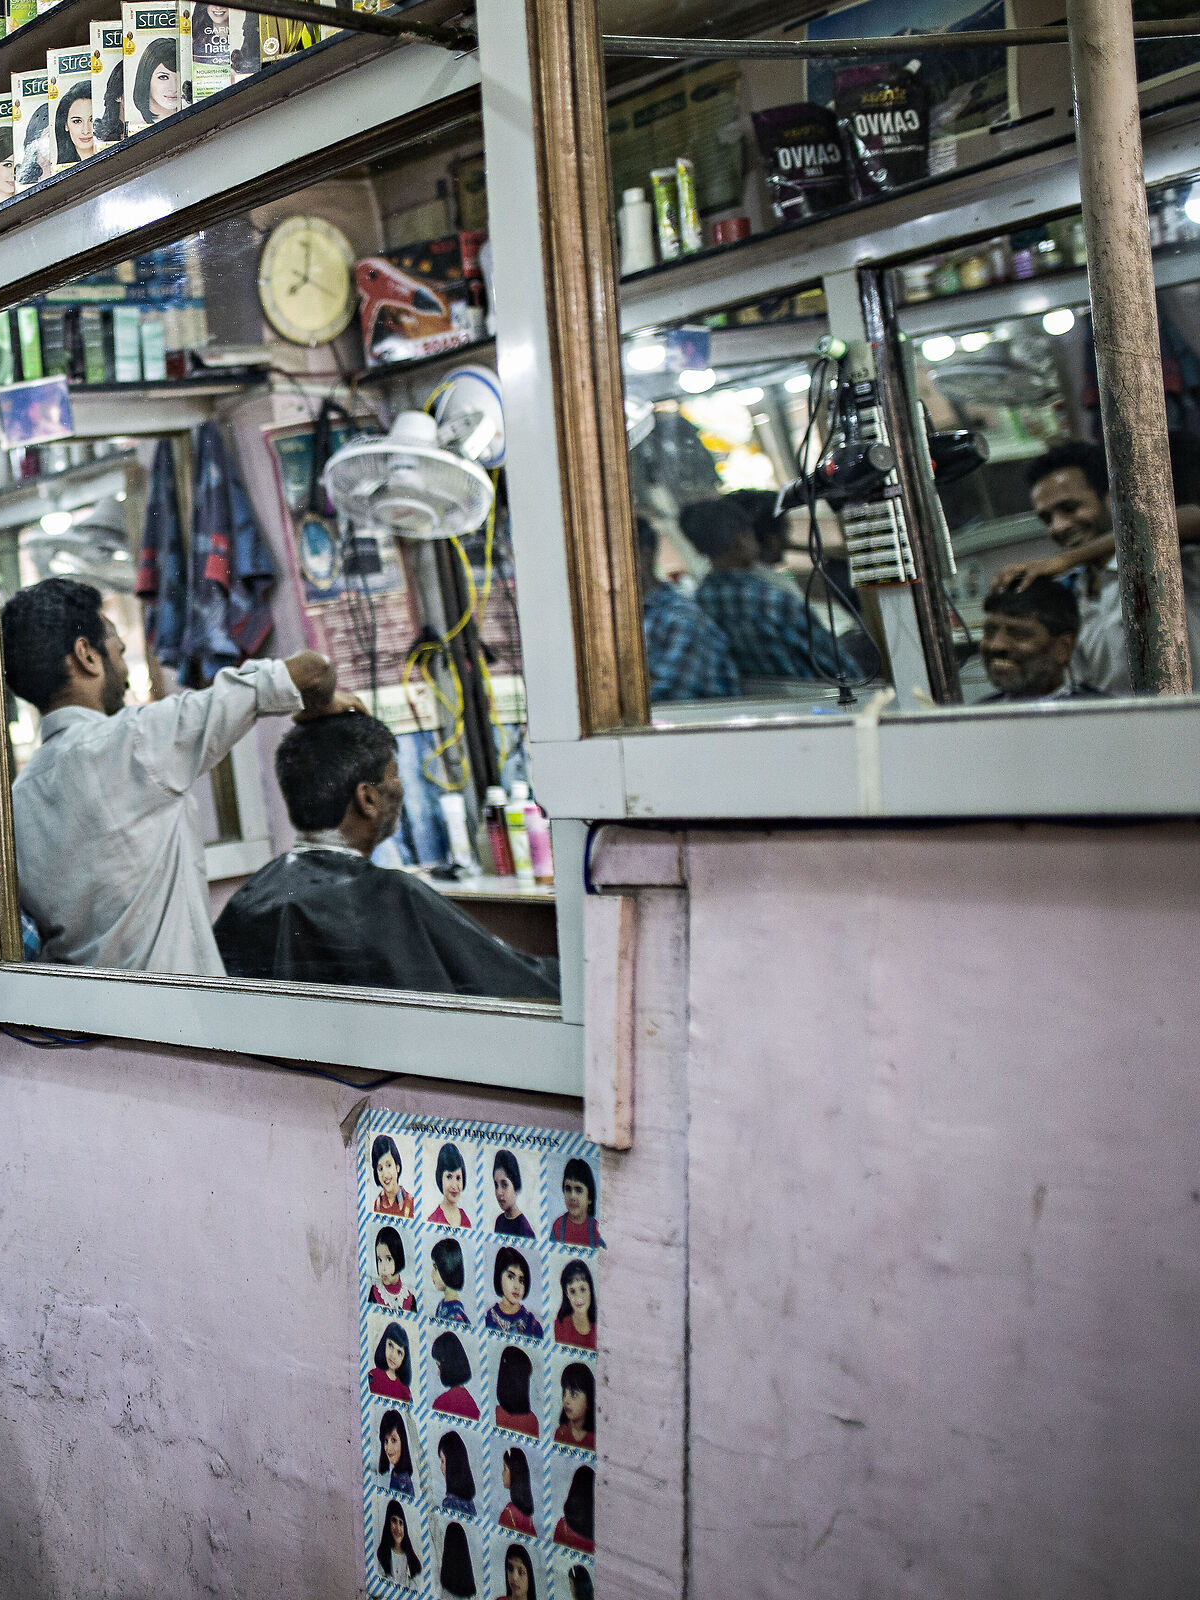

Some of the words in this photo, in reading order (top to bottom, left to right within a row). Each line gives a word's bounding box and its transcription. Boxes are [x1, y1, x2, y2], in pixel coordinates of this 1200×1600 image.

[60, 57, 91, 71] stre
[442, 1126, 462, 1137] BABY
[464, 1128, 485, 1140] HAIR
